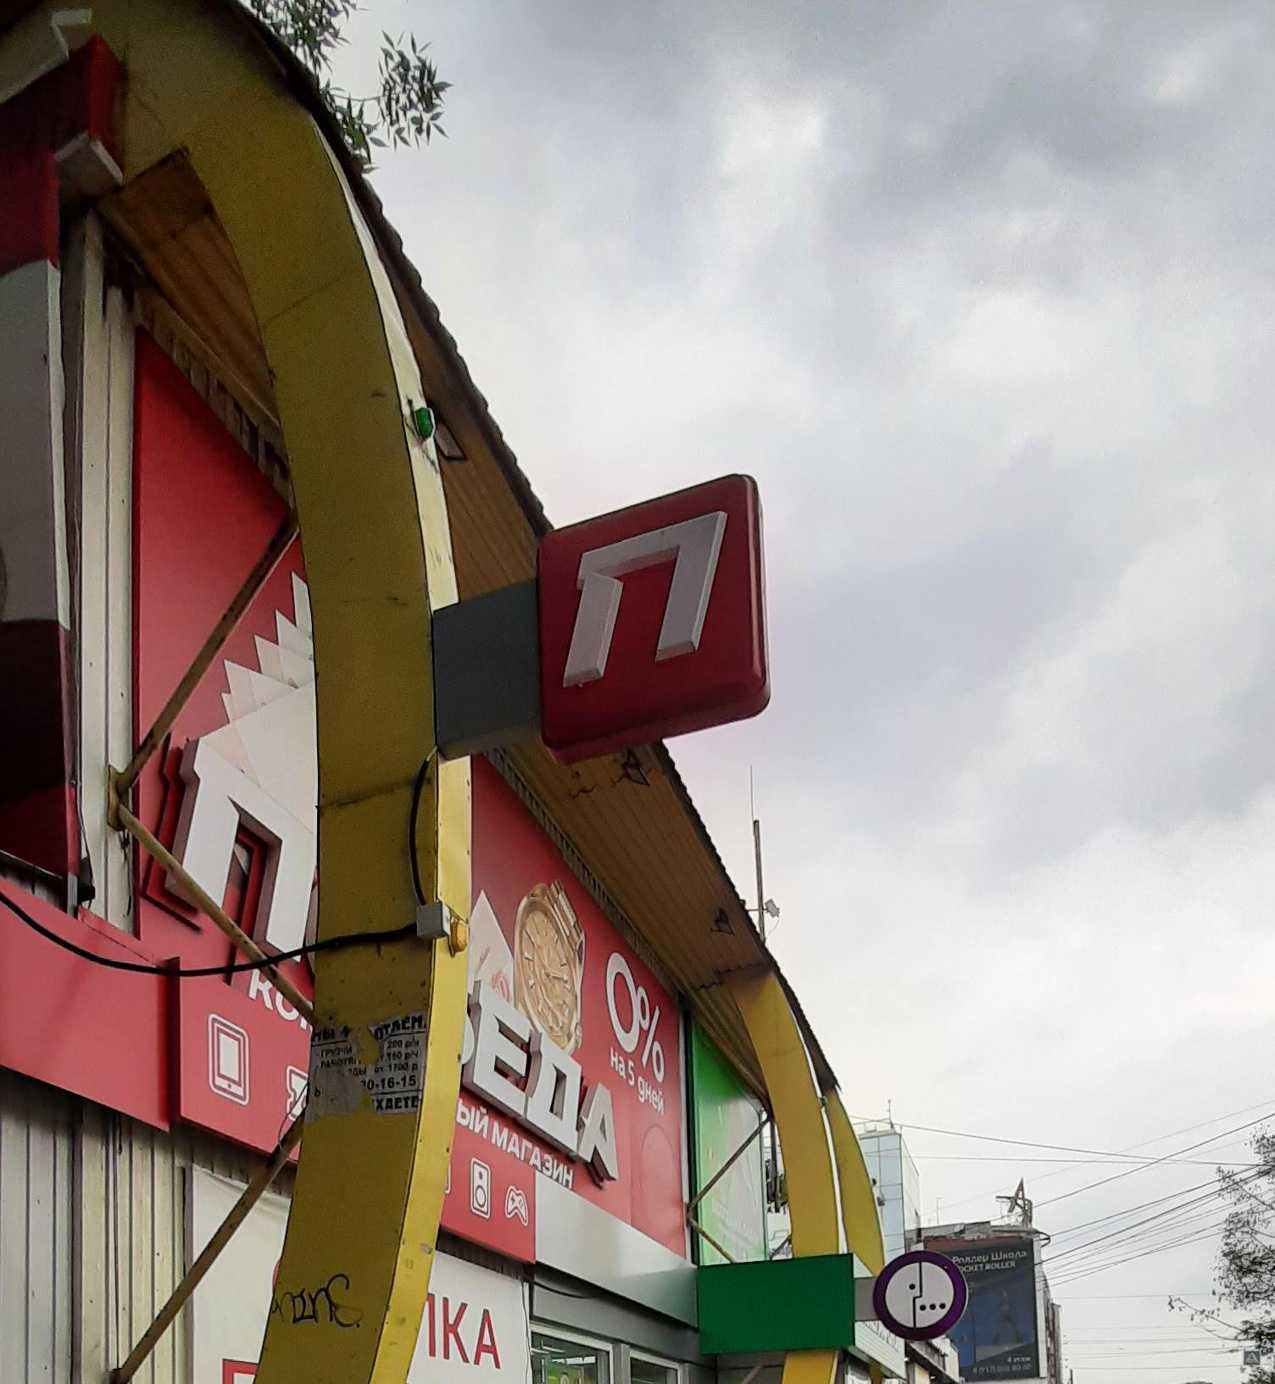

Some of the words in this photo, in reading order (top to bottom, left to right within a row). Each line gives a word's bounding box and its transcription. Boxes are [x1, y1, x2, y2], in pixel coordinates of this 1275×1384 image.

[563, 511, 728, 688] П
[606, 952, 665, 1083] 0%
[610, 1048, 627, 1079] на
[628, 1062, 635, 1086] 5
[637, 1076, 664, 1116] дней
[491, 1119, 574, 1190] МАГАЗИН
[960, 1264, 985, 1274] OCKET
